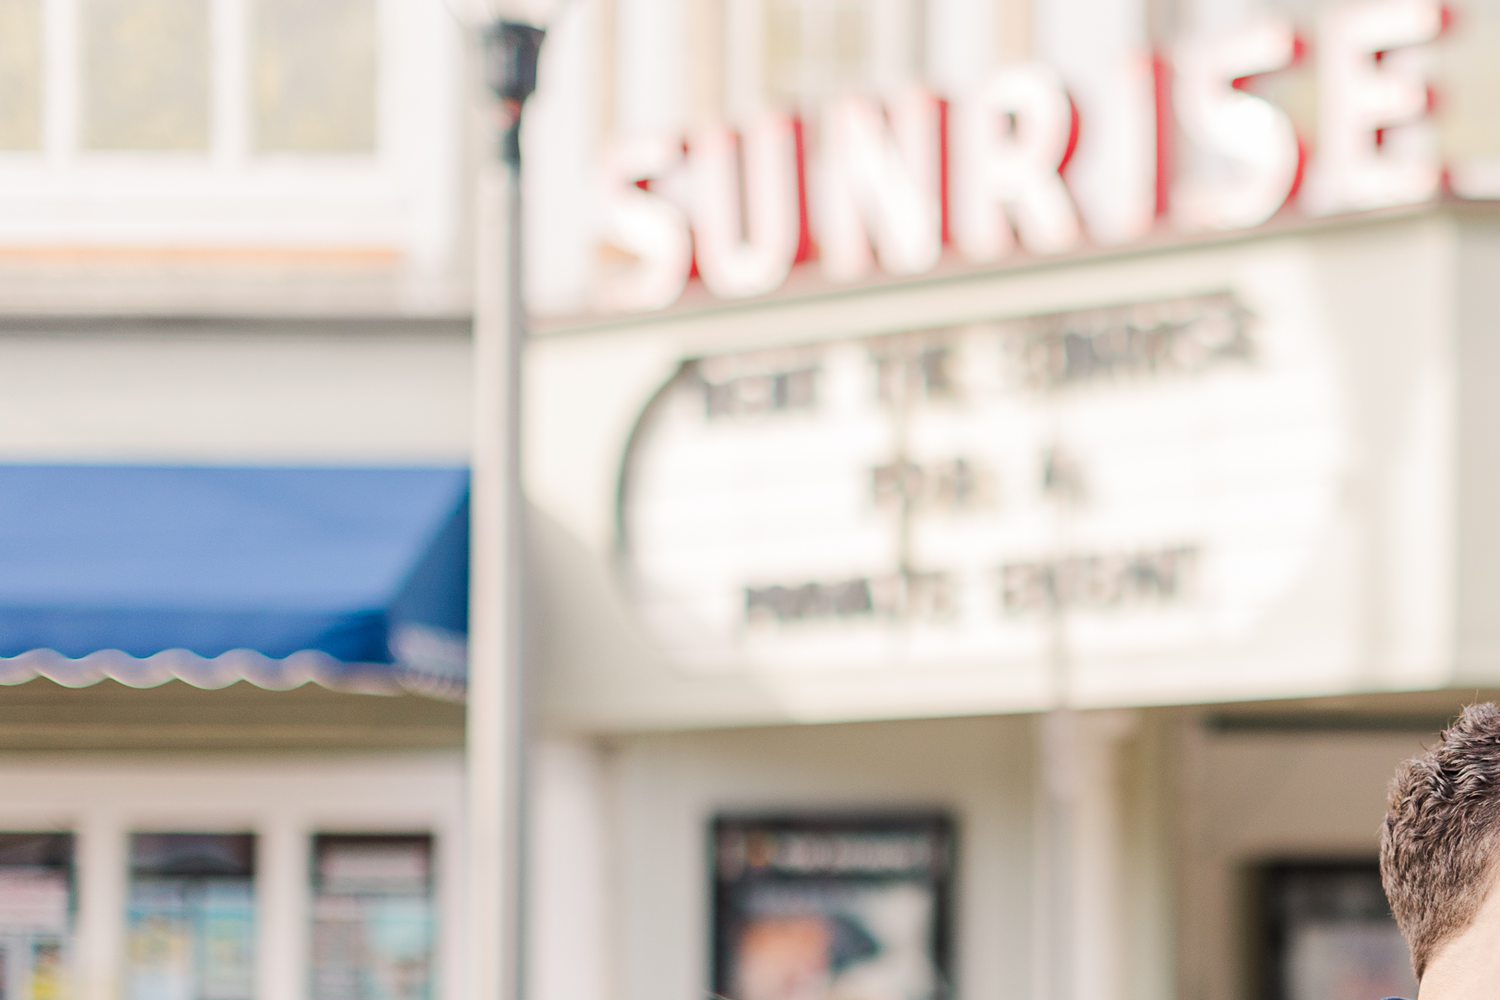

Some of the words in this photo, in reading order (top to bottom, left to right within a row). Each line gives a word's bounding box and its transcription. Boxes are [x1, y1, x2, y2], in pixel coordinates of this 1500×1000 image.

[598, 0, 1450, 312] SUNRISE
[738, 562, 968, 632] PRIVATE
[992, 538, 1206, 616] EVENT
